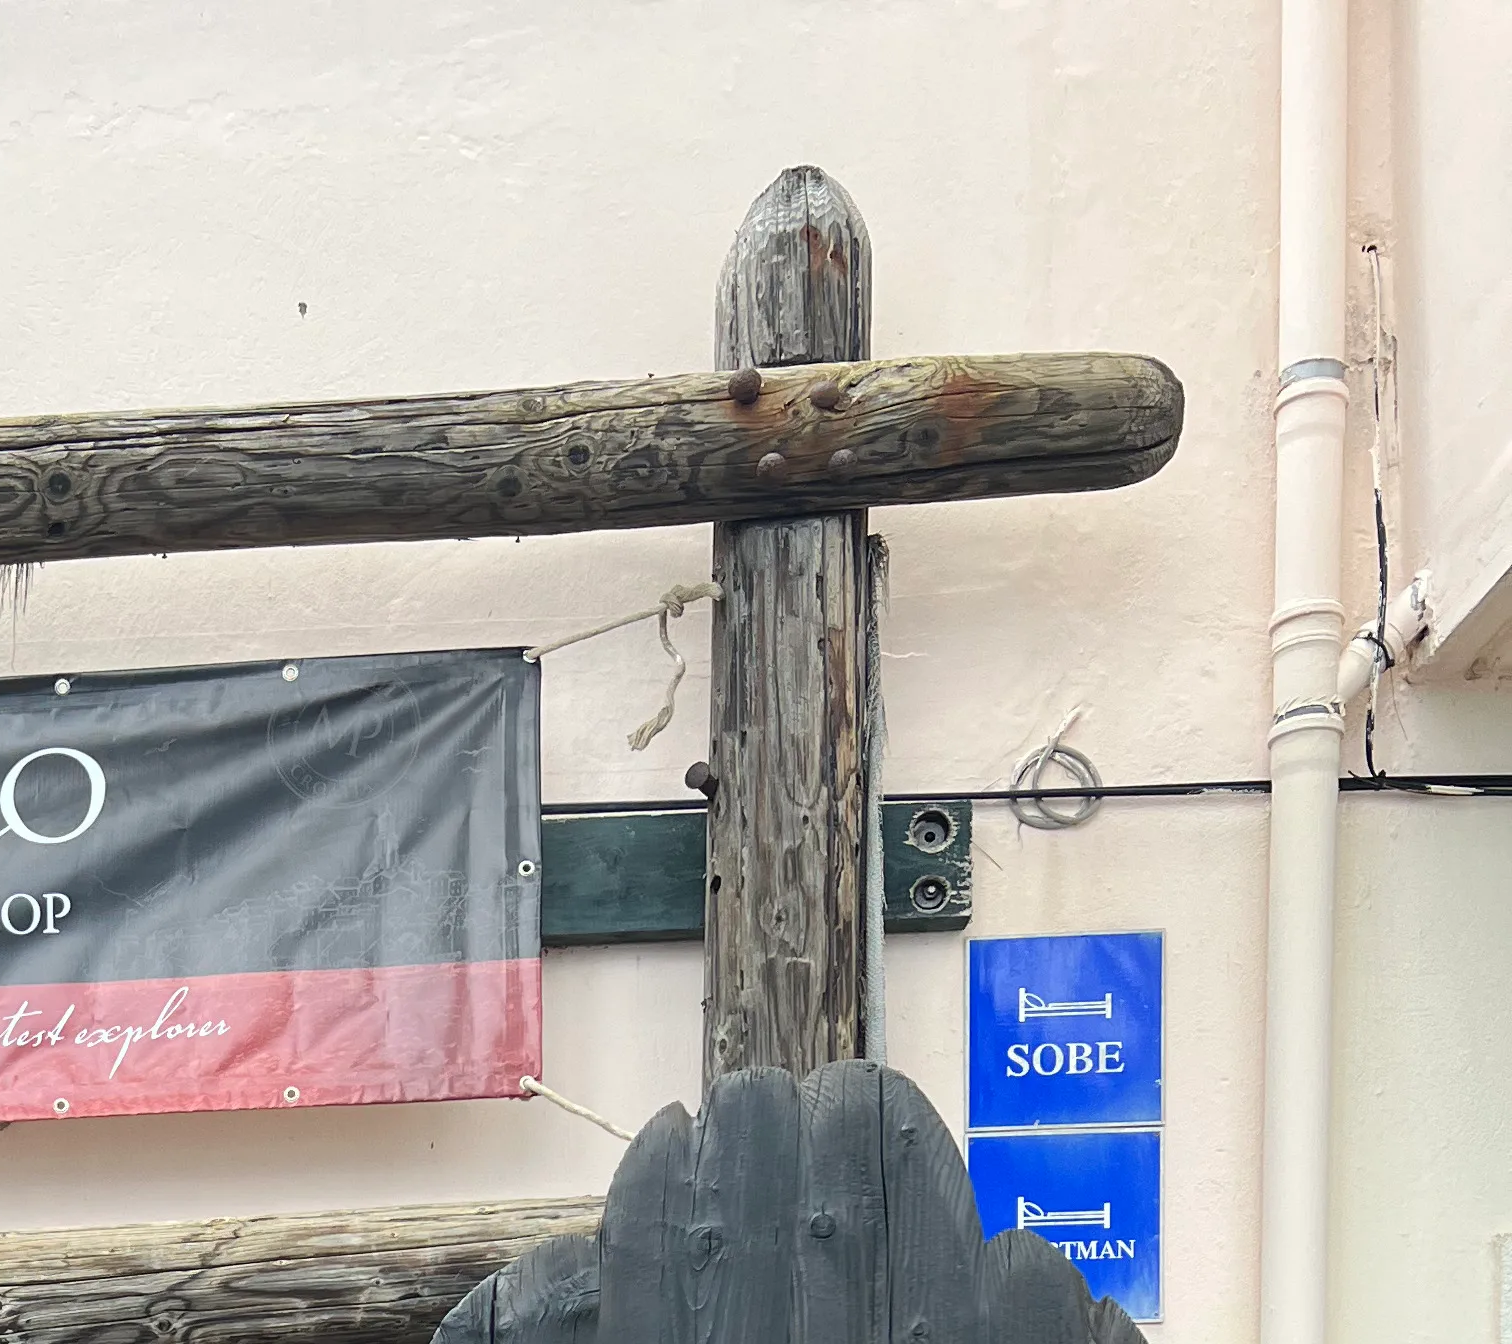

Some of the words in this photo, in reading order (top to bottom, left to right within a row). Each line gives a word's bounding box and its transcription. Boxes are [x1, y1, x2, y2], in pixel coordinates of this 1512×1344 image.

[74, 985, 232, 1080] explorer
[1006, 1041, 1125, 1078] SOBE
[1048, 1239, 1136, 1261] TMAN
